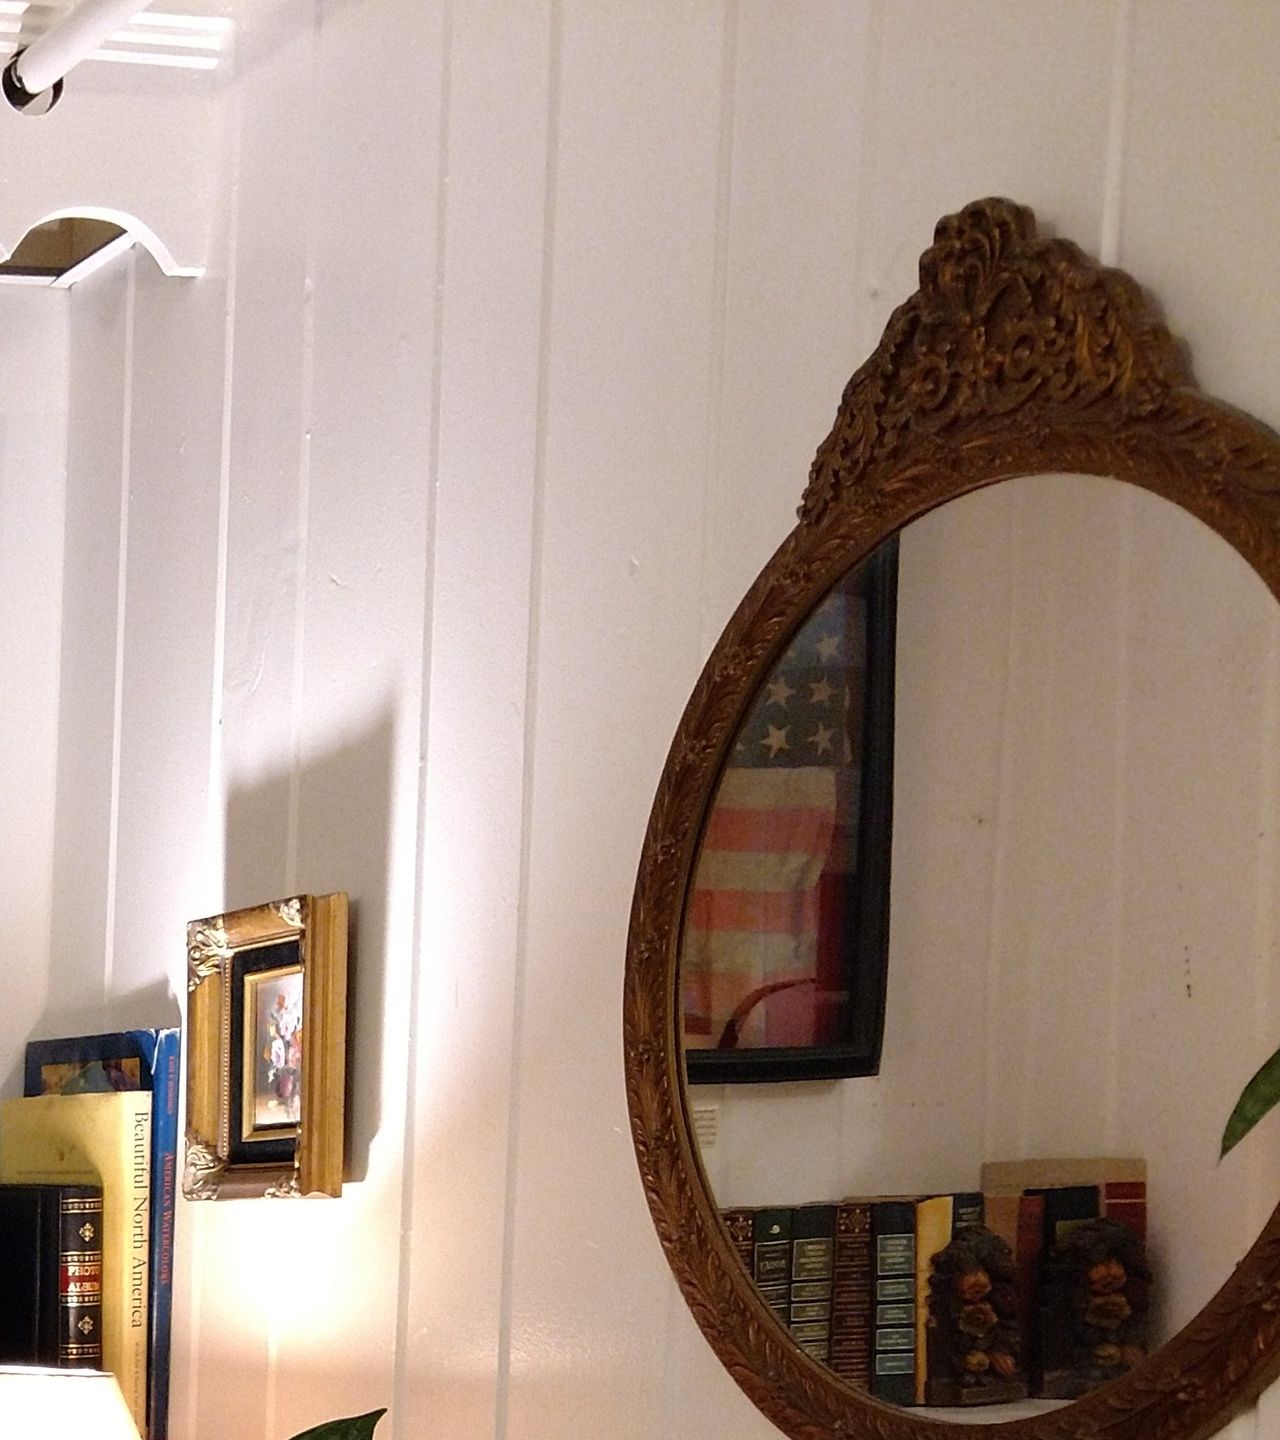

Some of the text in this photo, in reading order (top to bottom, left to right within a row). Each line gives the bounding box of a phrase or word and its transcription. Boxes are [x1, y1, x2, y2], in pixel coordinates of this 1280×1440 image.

[133, 1111, 149, 1189] Beautiful
[132, 1196, 148, 1249] North
[131, 1256, 147, 1328] America
